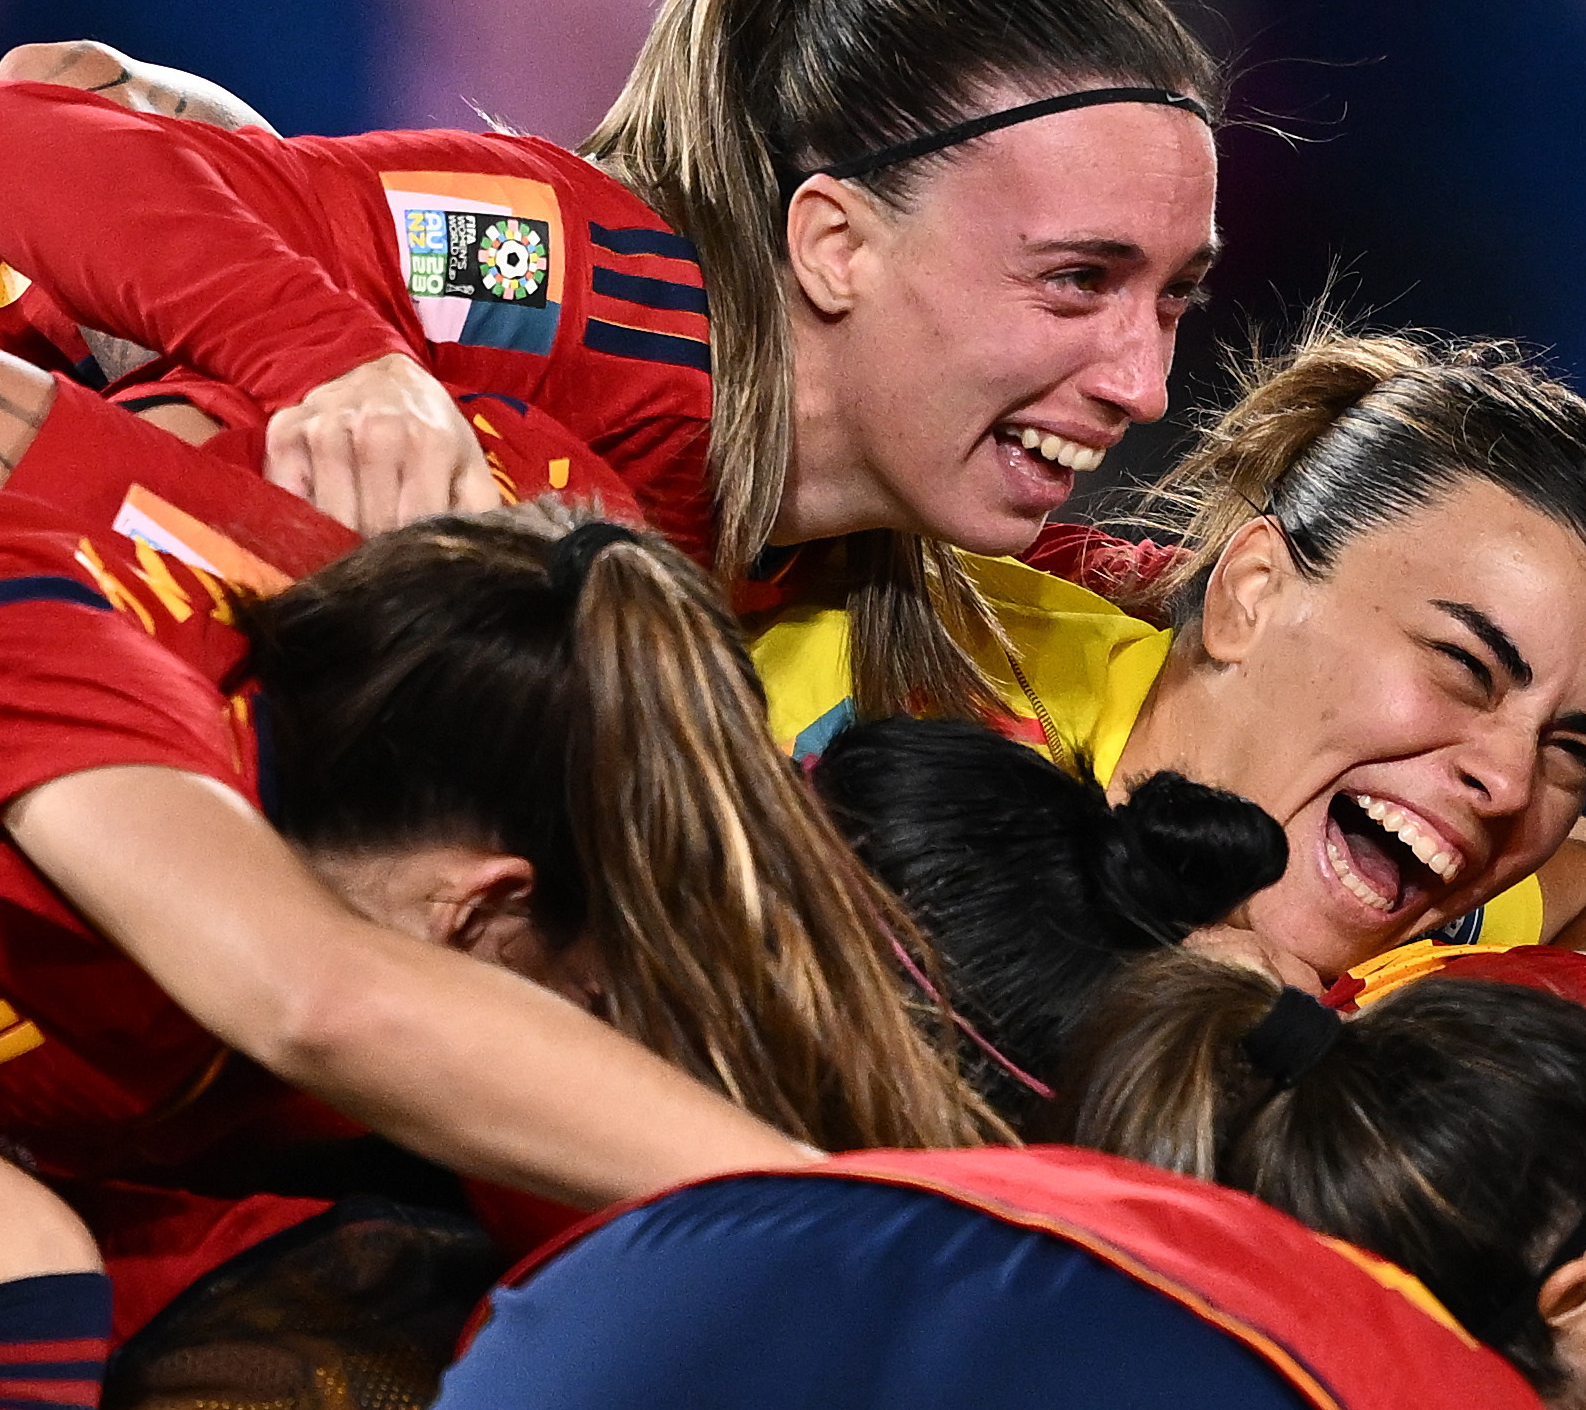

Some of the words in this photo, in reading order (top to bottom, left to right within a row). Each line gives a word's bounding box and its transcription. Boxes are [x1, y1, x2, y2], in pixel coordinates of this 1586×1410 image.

[407, 212, 426, 248] NZ
[425, 213, 444, 249] AU
[448, 215, 459, 256] WORLD
[465, 215, 477, 245] FIFA
[412, 256, 427, 292] 23
[426, 256, 444, 294] 20
[449, 256, 458, 281] CUP
